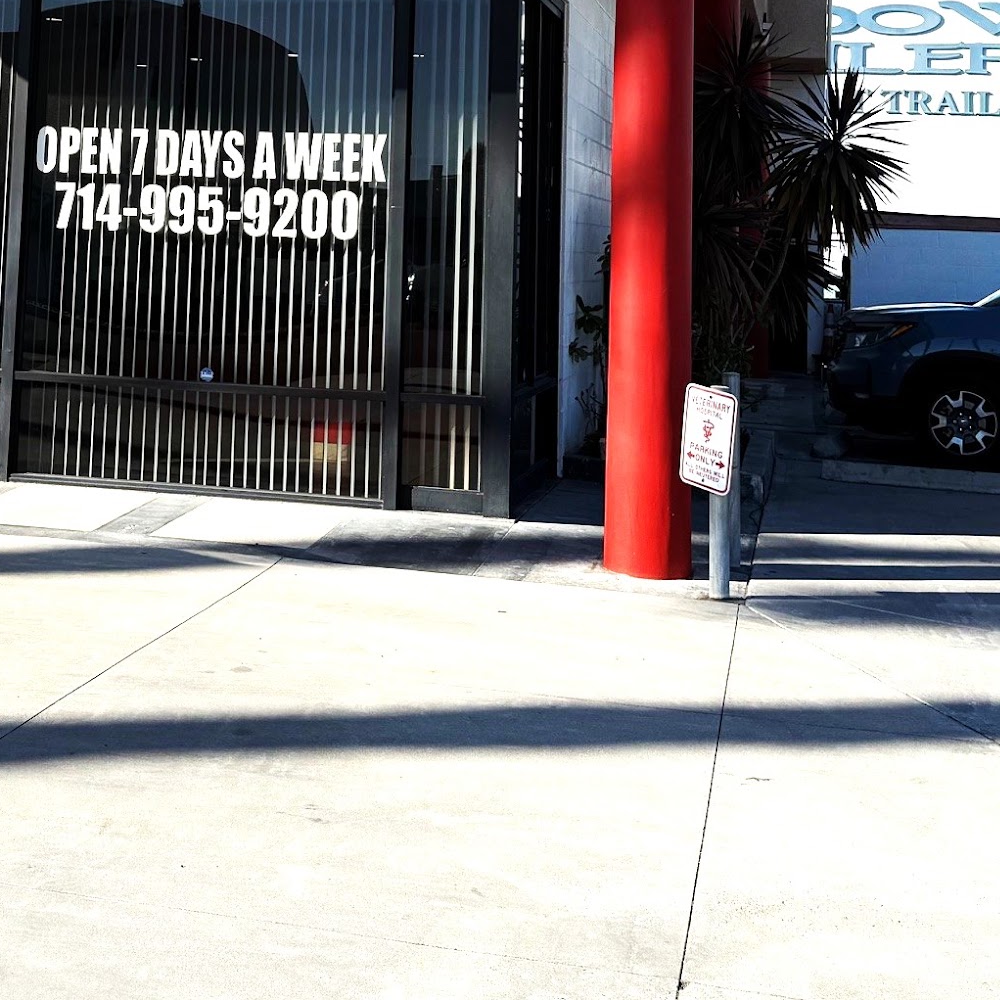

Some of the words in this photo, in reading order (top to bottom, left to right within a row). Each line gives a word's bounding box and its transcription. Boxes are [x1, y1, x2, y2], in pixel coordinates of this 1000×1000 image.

[36, 125, 123, 175] OPEN
[131, 128, 149, 176] 7
[156, 128, 246, 180] DAYS
[252, 131, 277, 180] A
[285, 132, 388, 183] WEEK
[55, 181, 359, 241] 714-995-9200
[689, 441, 723, 459] PARKING
[695, 453, 716, 467] ONLY
